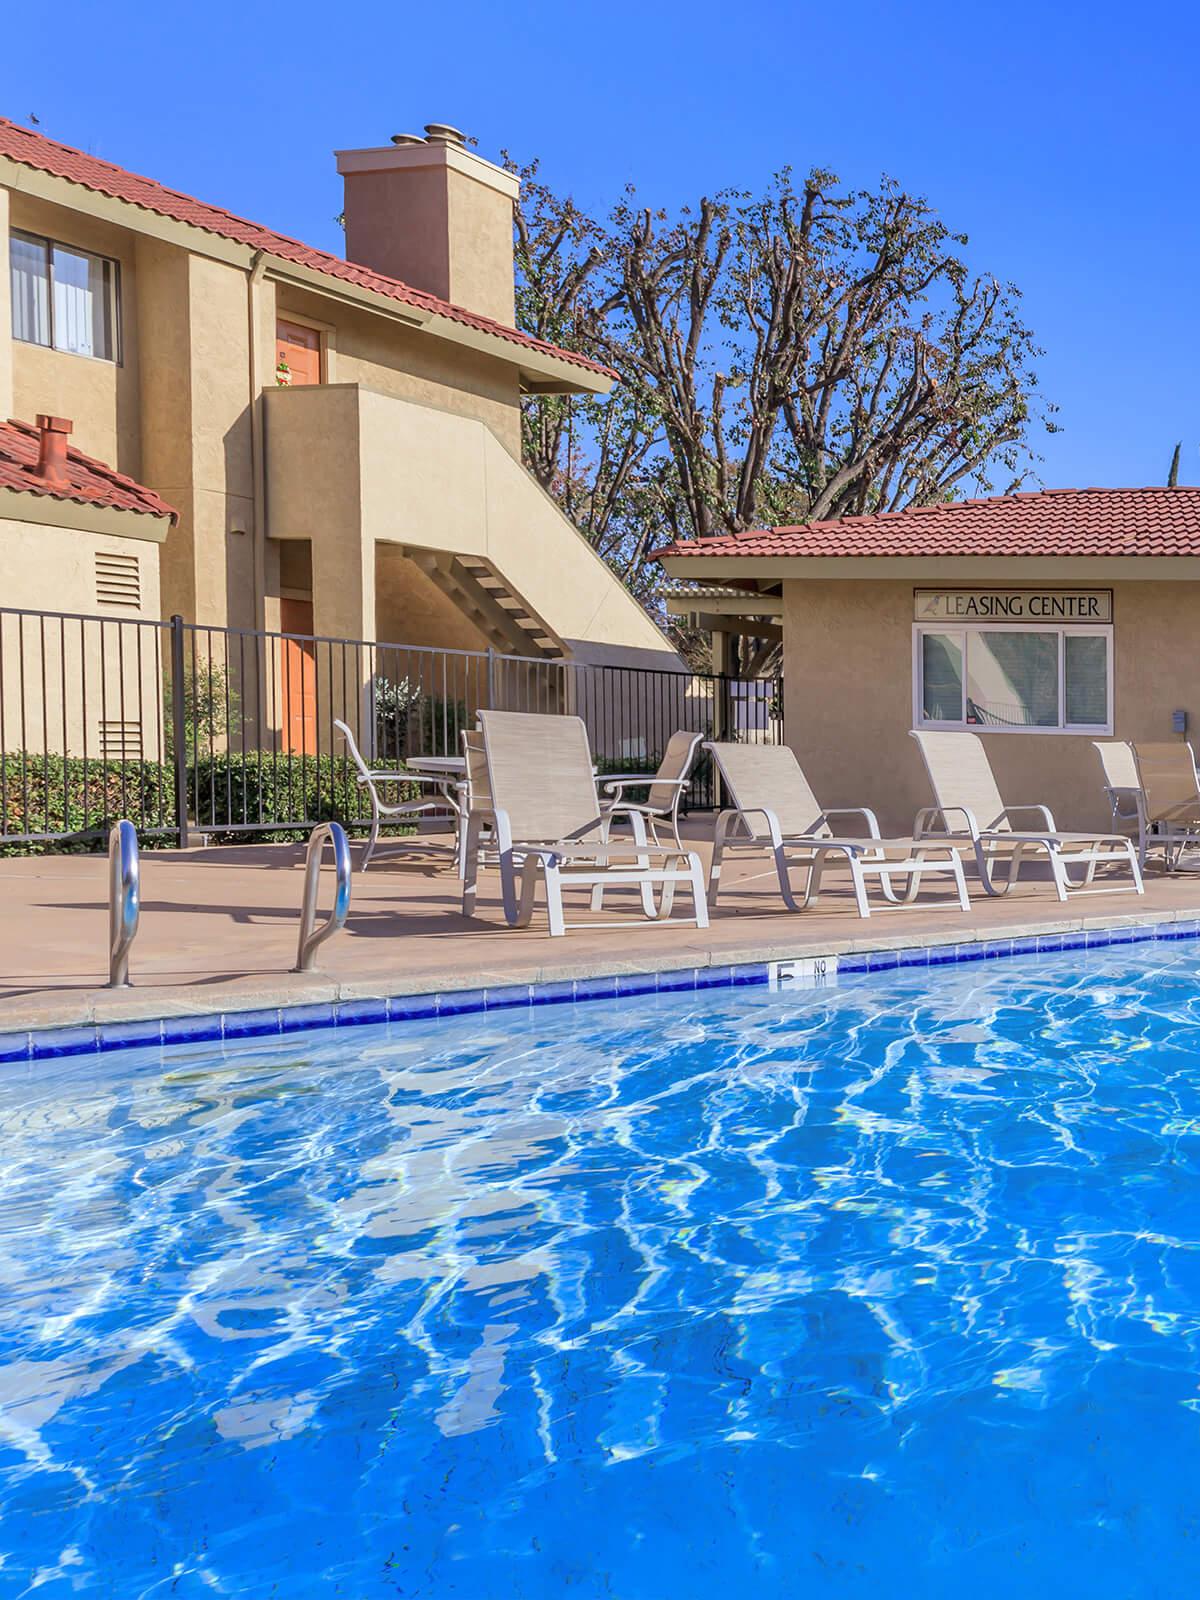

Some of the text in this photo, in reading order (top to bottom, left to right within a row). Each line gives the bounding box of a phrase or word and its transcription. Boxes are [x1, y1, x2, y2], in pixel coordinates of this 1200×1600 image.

[945, 596, 1100, 616] LEASING CENTER
[814, 960, 827, 974] NO
